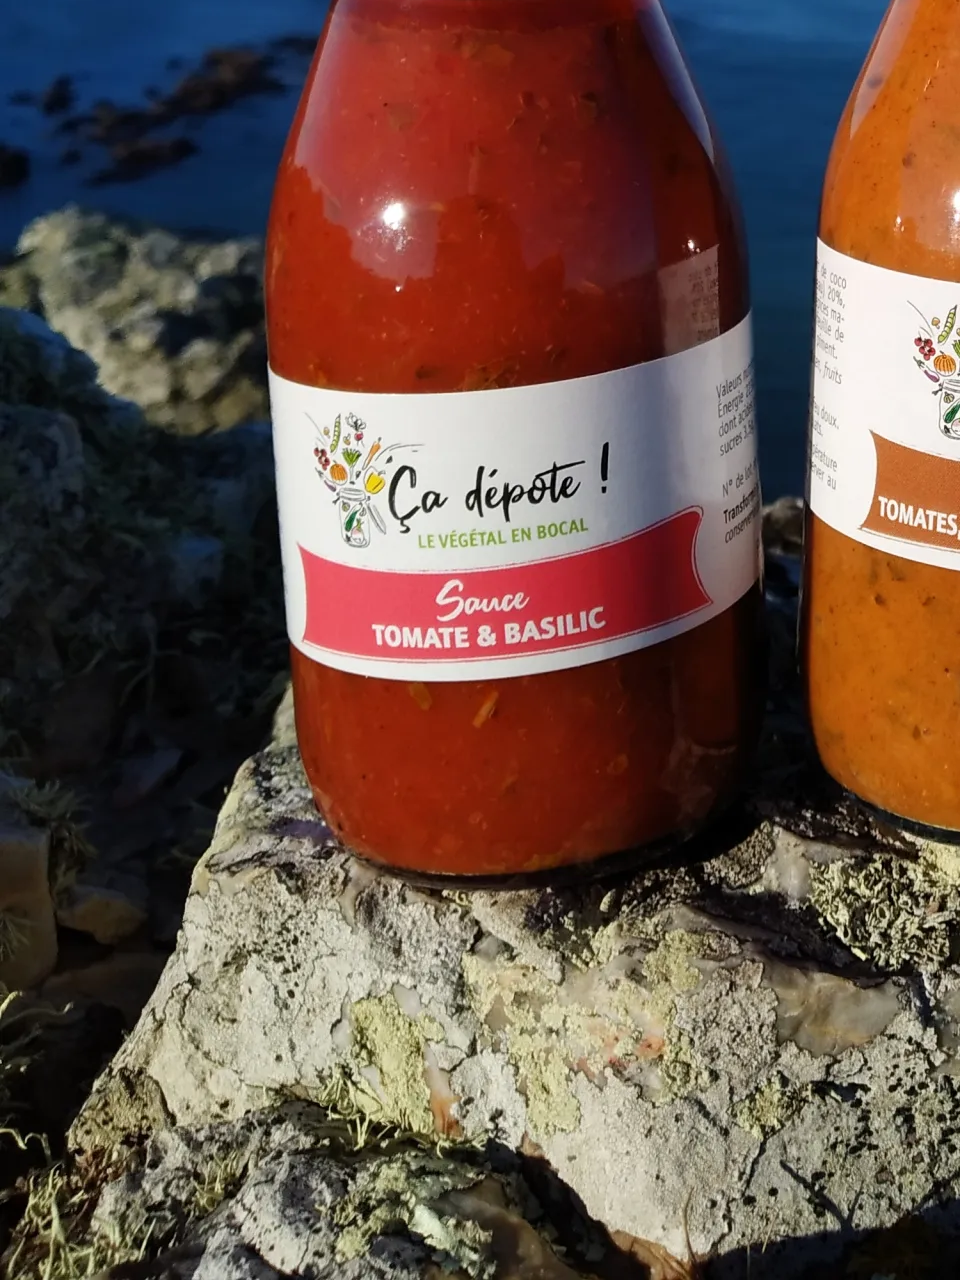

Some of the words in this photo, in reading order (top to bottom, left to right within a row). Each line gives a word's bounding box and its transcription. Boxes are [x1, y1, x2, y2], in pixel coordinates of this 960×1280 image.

[829, 271, 847, 290] coco
[827, 285, 846, 309] 20%,
[835, 325, 845, 344] de
[716, 373, 743, 399] Valeurs
[822, 361, 843, 385] fruits
[717, 390, 744, 419] Énergie
[820, 404, 840, 430] doux.
[718, 414, 738, 438] dont
[720, 431, 743, 457] sucres
[388, 465, 447, 534] Ça
[465, 460, 586, 523] dépote
[599, 441, 610, 494] !
[417, 533, 436, 550] LE
[438, 527, 508, 549] VÉGÉTAL
[512, 525, 532, 544] EN
[537, 517, 589, 539] BOCAL
[436, 579, 530, 623] Sauce
[372, 624, 470, 649] TOMATE
[477, 625, 497, 648] &
[505, 606, 607, 646] BASILIC
